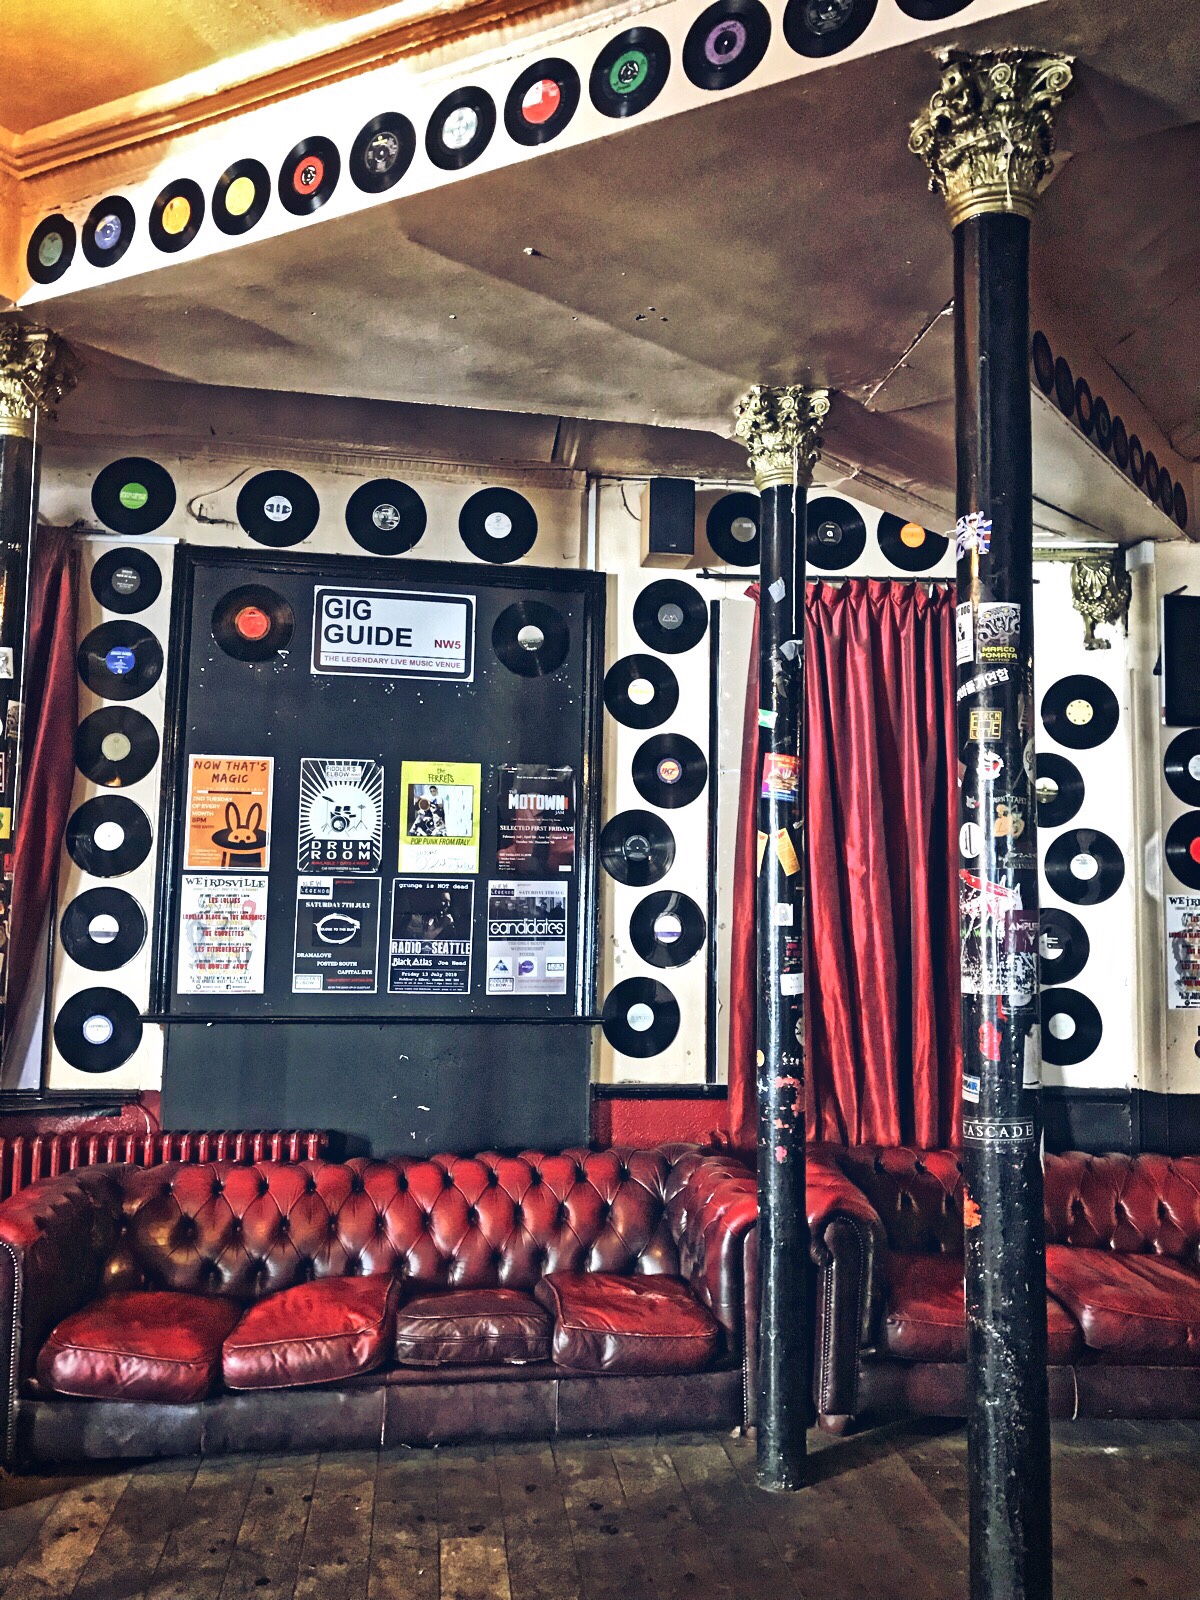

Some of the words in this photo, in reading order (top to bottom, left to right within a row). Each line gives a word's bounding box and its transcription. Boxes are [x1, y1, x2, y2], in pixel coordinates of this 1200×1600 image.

[324, 598, 372, 620] GIG
[324, 624, 412, 647] GUIDE
[434, 640, 461, 649] NW5
[342, 656, 389, 665] LEGENDARY
[434, 661, 461, 669] VENUE
[194, 761, 221, 770] NOW
[226, 761, 267, 772] THAT'S
[212, 774, 249, 783] MAGIC
[428, 774, 455, 783] FERRETS
[508, 794, 565, 811] MOTOWN
[312, 841, 371, 850] DRUM
[455, 838, 471, 846] ITALY
[311, 850, 371, 860] ROOM
[490, 918, 564, 935] candidates
[391, 941, 422, 954] RADIO
[432, 942, 471, 955] SEATTLE
[392, 958, 412, 967] Black
[412, 958, 433, 967] Atlas
